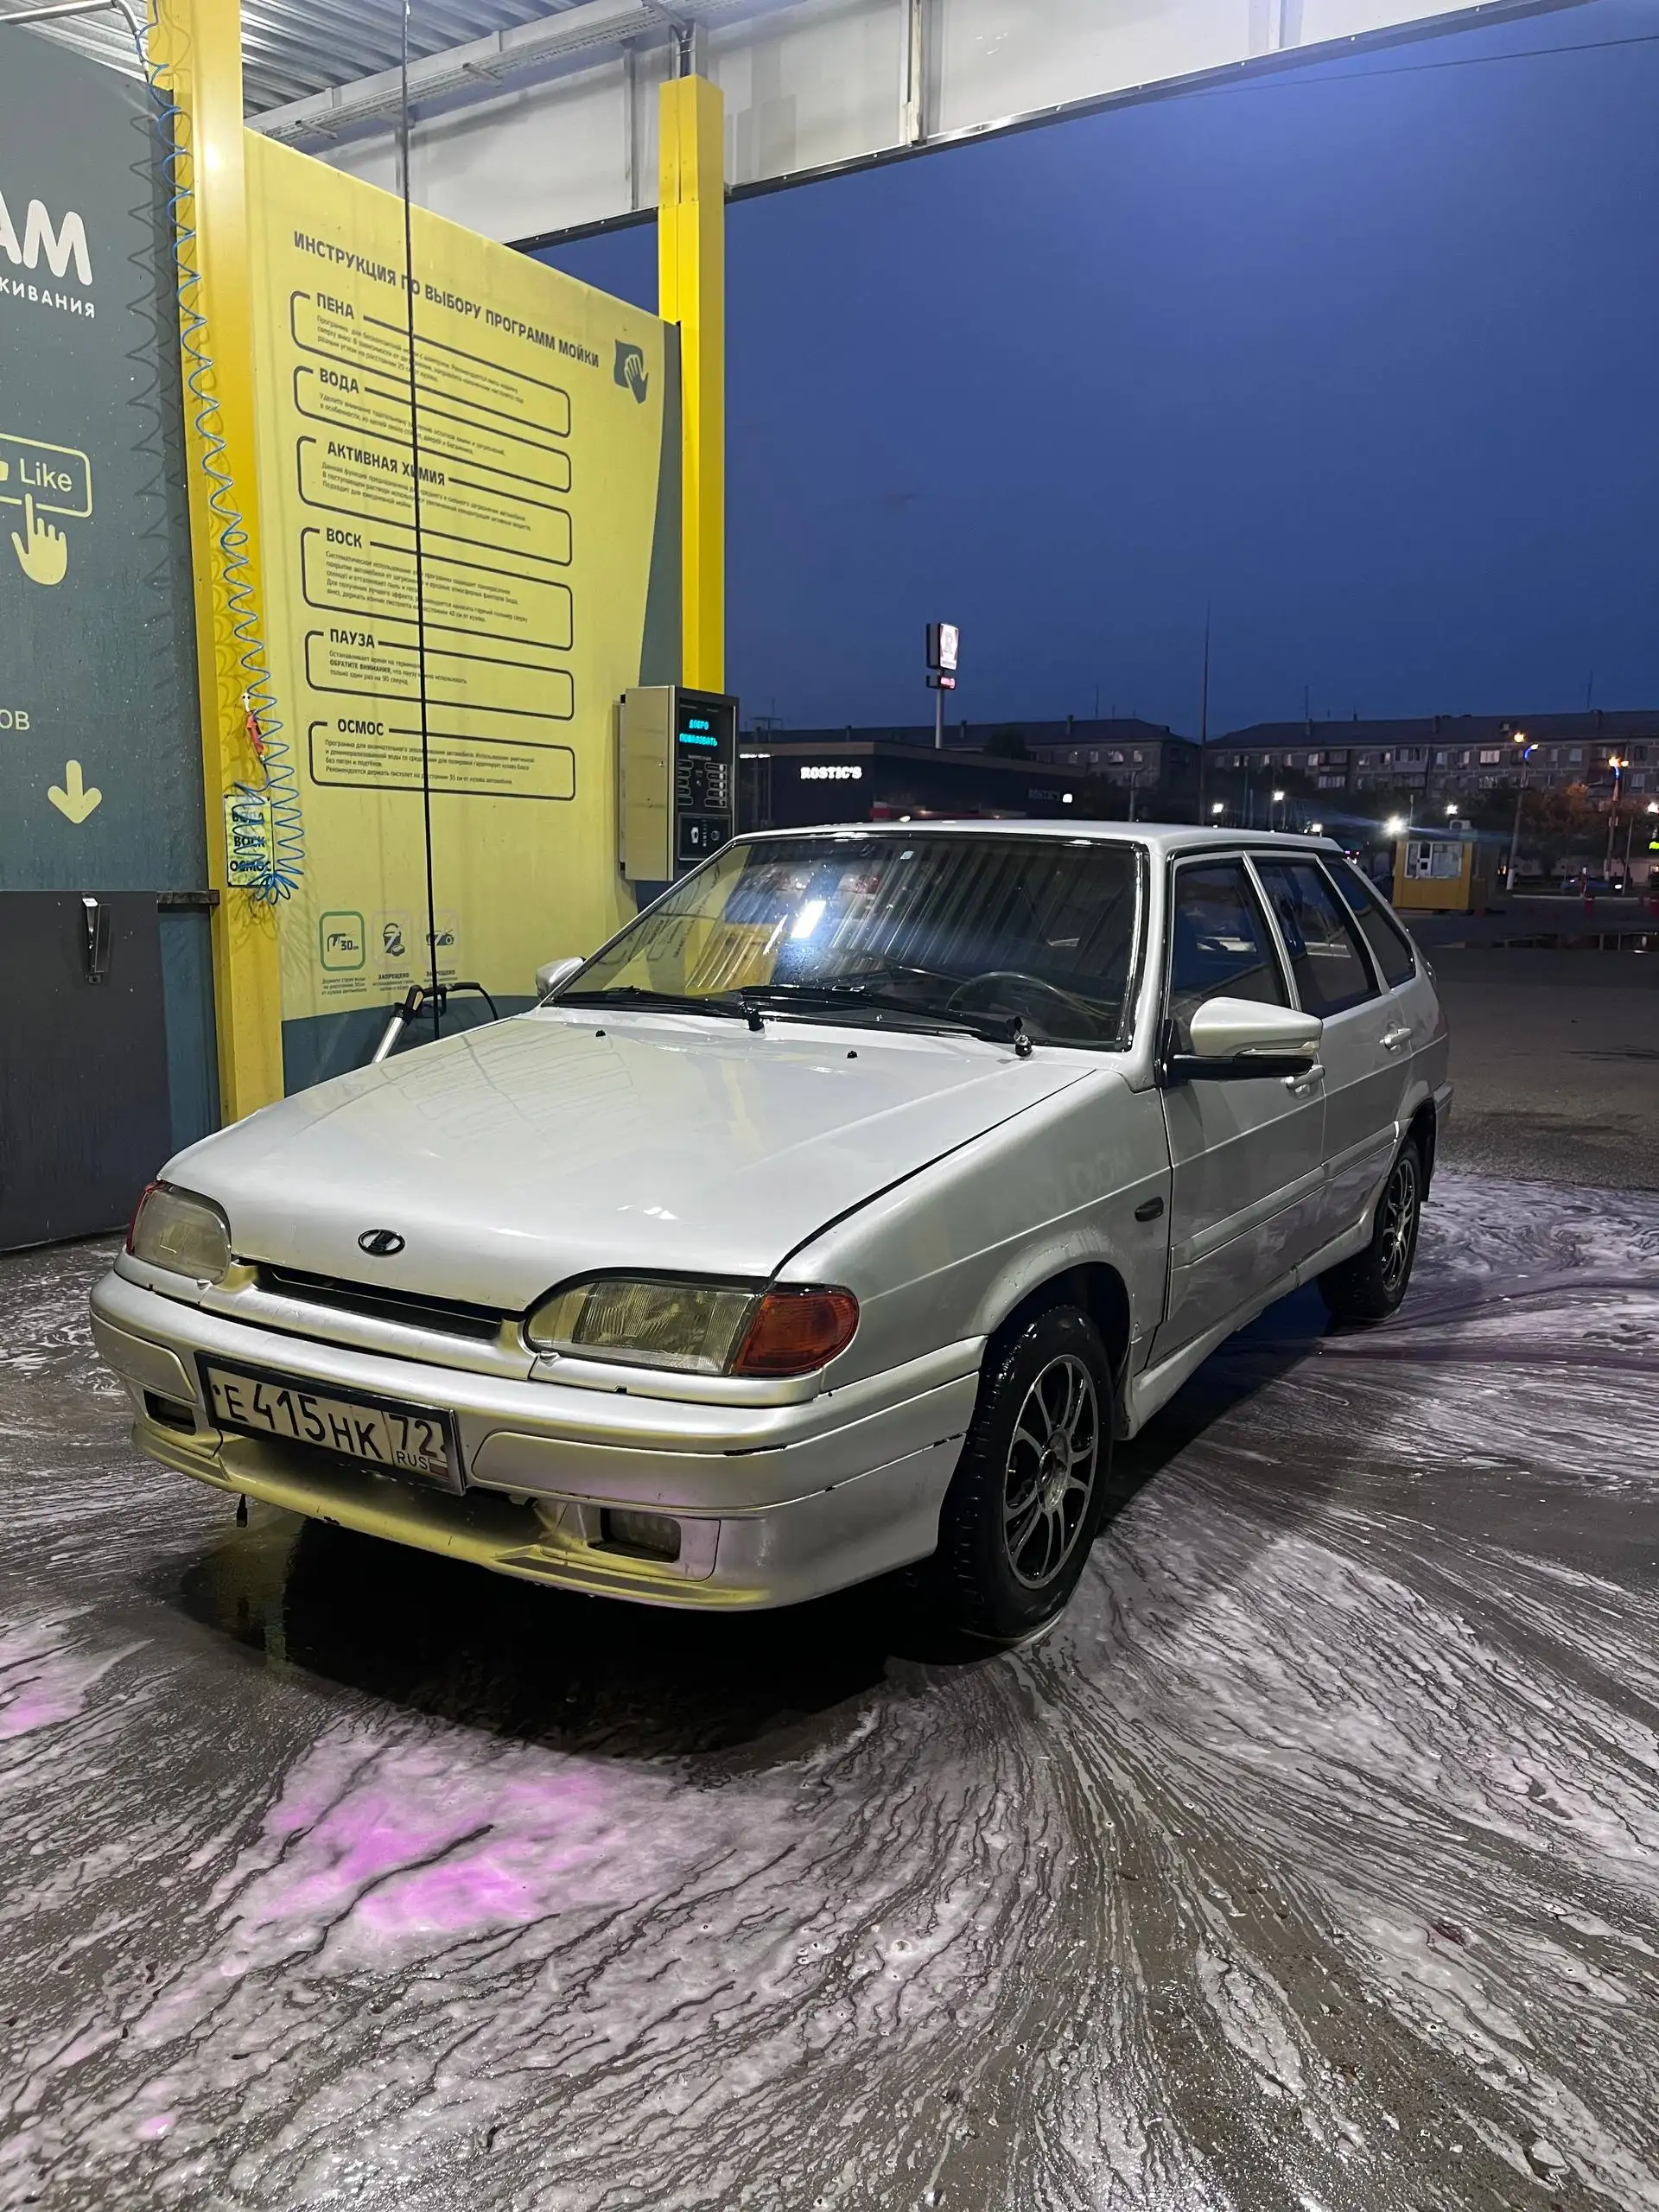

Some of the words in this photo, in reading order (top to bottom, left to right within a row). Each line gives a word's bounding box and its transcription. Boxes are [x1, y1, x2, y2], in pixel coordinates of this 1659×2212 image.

[294, 231, 397, 286] ИНСТРУКЦИЯ
[401, 274, 421, 296] ПО
[425, 283, 481, 319] ВЫБОРУ
[486, 308, 556, 351] ПРОГРАММ
[559, 338, 600, 368] МОЙКИ
[316, 292, 354, 320] ПЕНА
[320, 367, 359, 394] ВОДА
[327, 441, 397, 474] АКТИВНАЯ
[20, 458, 73, 492] Like
[326, 527, 362, 549] ВОСК
[330, 628, 375, 648] ПАУЗА
[338, 718, 384, 736] ОСМОС
[800, 766, 862, 779] ROSTIC'S
[340, 939, 353, 950] 30
[389, 1414, 437, 1459] 72
[396, 1451, 429, 1470] RUS
